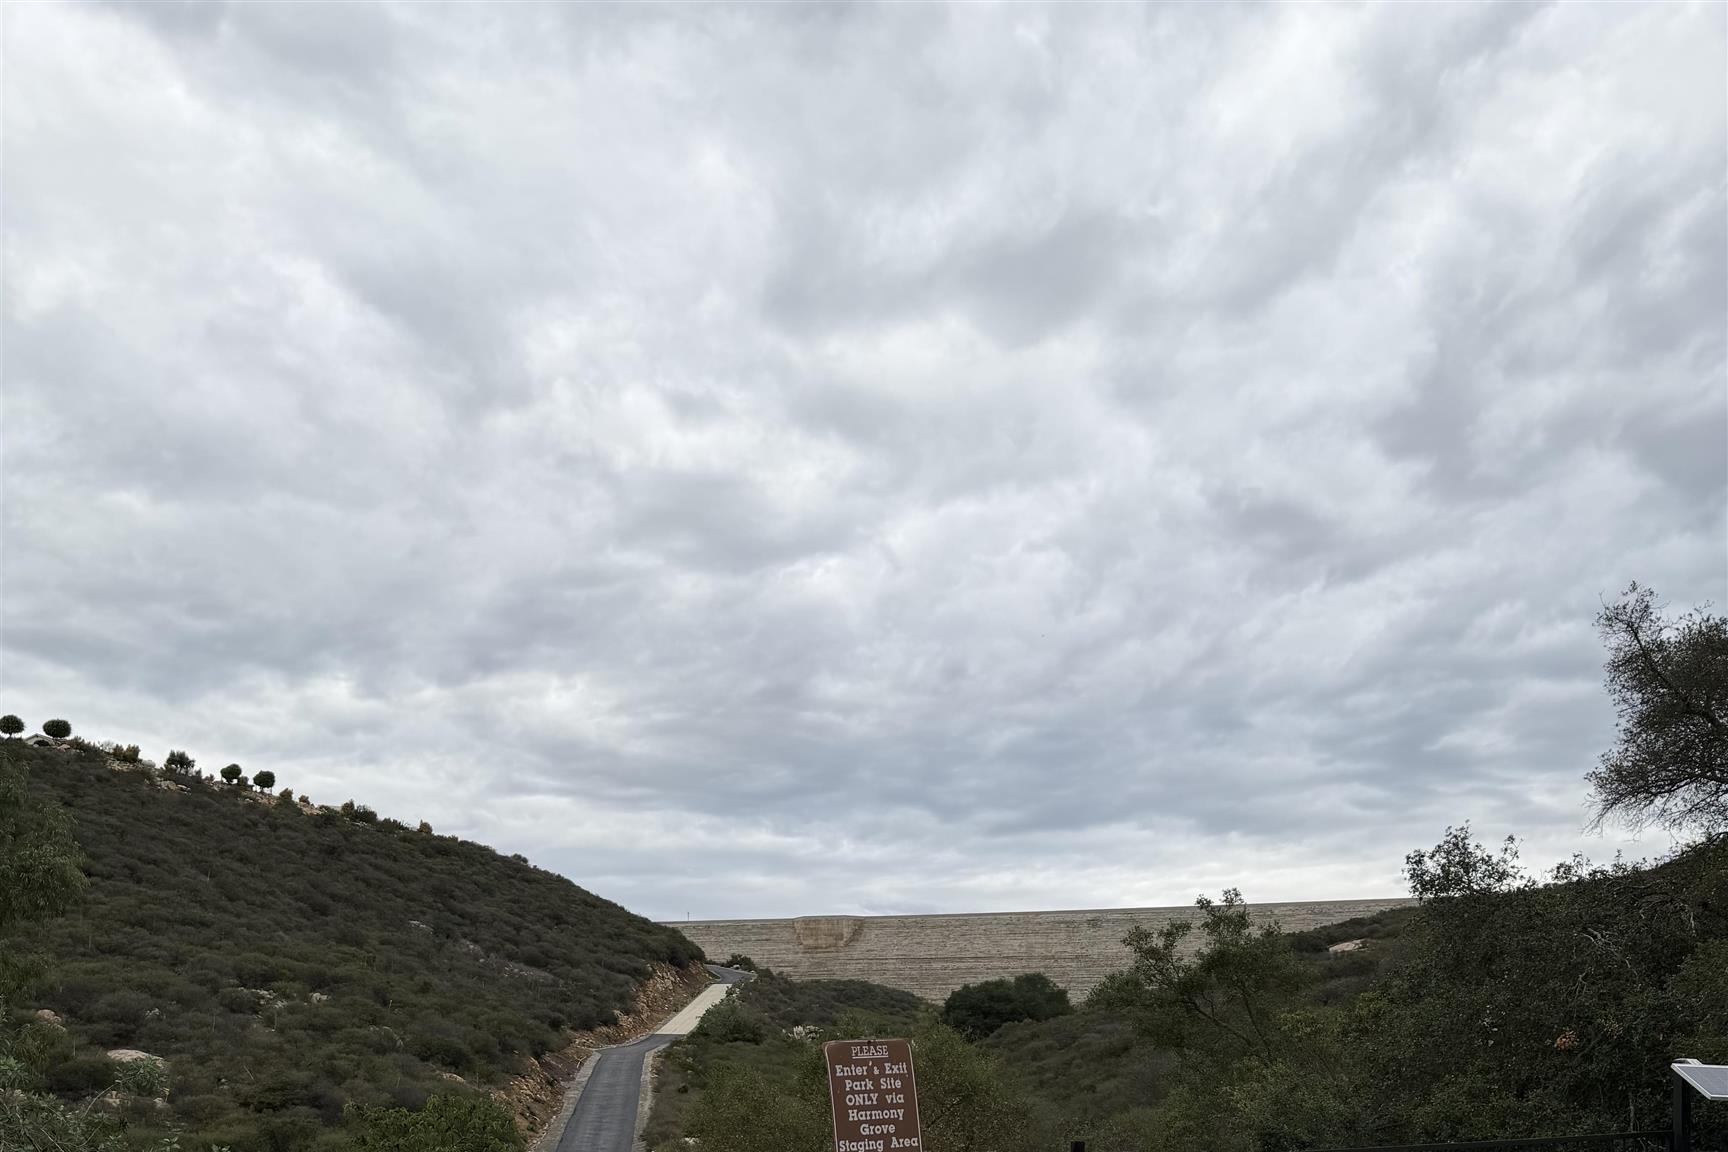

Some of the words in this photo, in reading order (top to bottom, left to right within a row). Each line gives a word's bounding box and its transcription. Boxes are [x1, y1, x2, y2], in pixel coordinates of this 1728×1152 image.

[851, 1045, 889, 1057] PLEASE
[873, 1066, 880, 1075] &
[884, 1062, 908, 1074] Exit
[845, 1079, 874, 1091] Park
[880, 1077, 902, 1089] Site
[846, 1093, 879, 1106] ONLY
[885, 1092, 905, 1104] via
[848, 1108, 905, 1121] Harmony
[860, 1123, 896, 1136] Grove
[890, 1136, 919, 1149] Area
